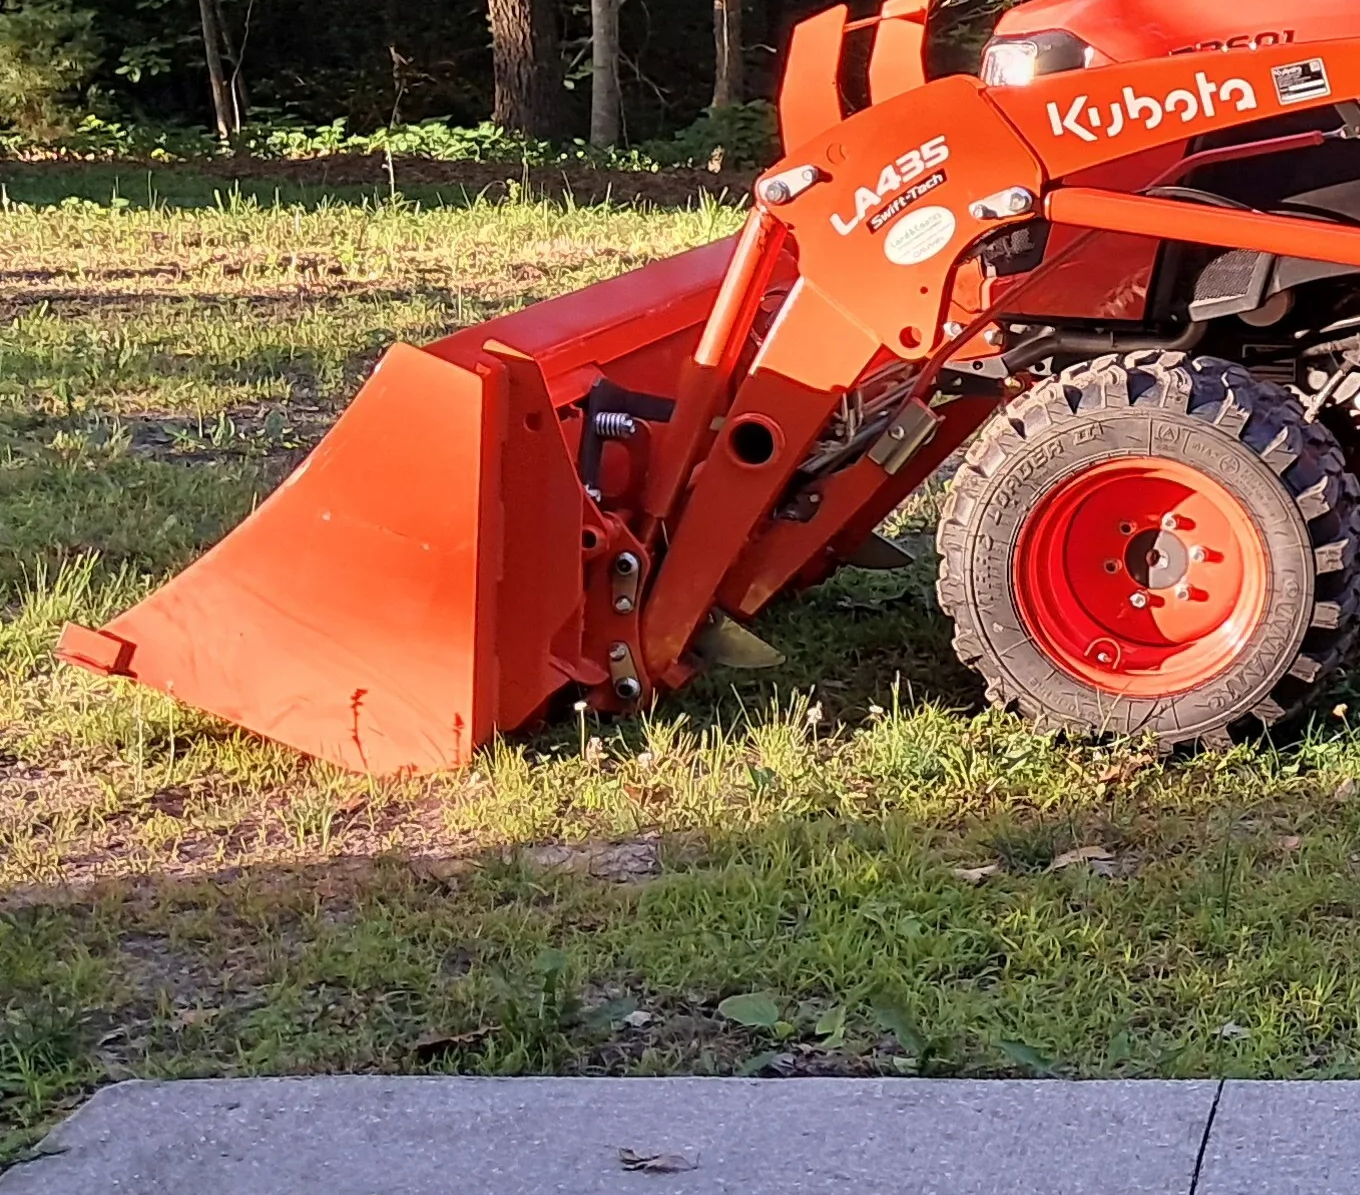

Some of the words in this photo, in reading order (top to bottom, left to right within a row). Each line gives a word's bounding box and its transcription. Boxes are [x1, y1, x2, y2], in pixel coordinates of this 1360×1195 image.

[1046, 71, 1258, 142] Kubota
[829, 134, 951, 237] LA435
[871, 172, 945, 231] Swift-Tech
[988, 438, 1065, 527] LOADER
